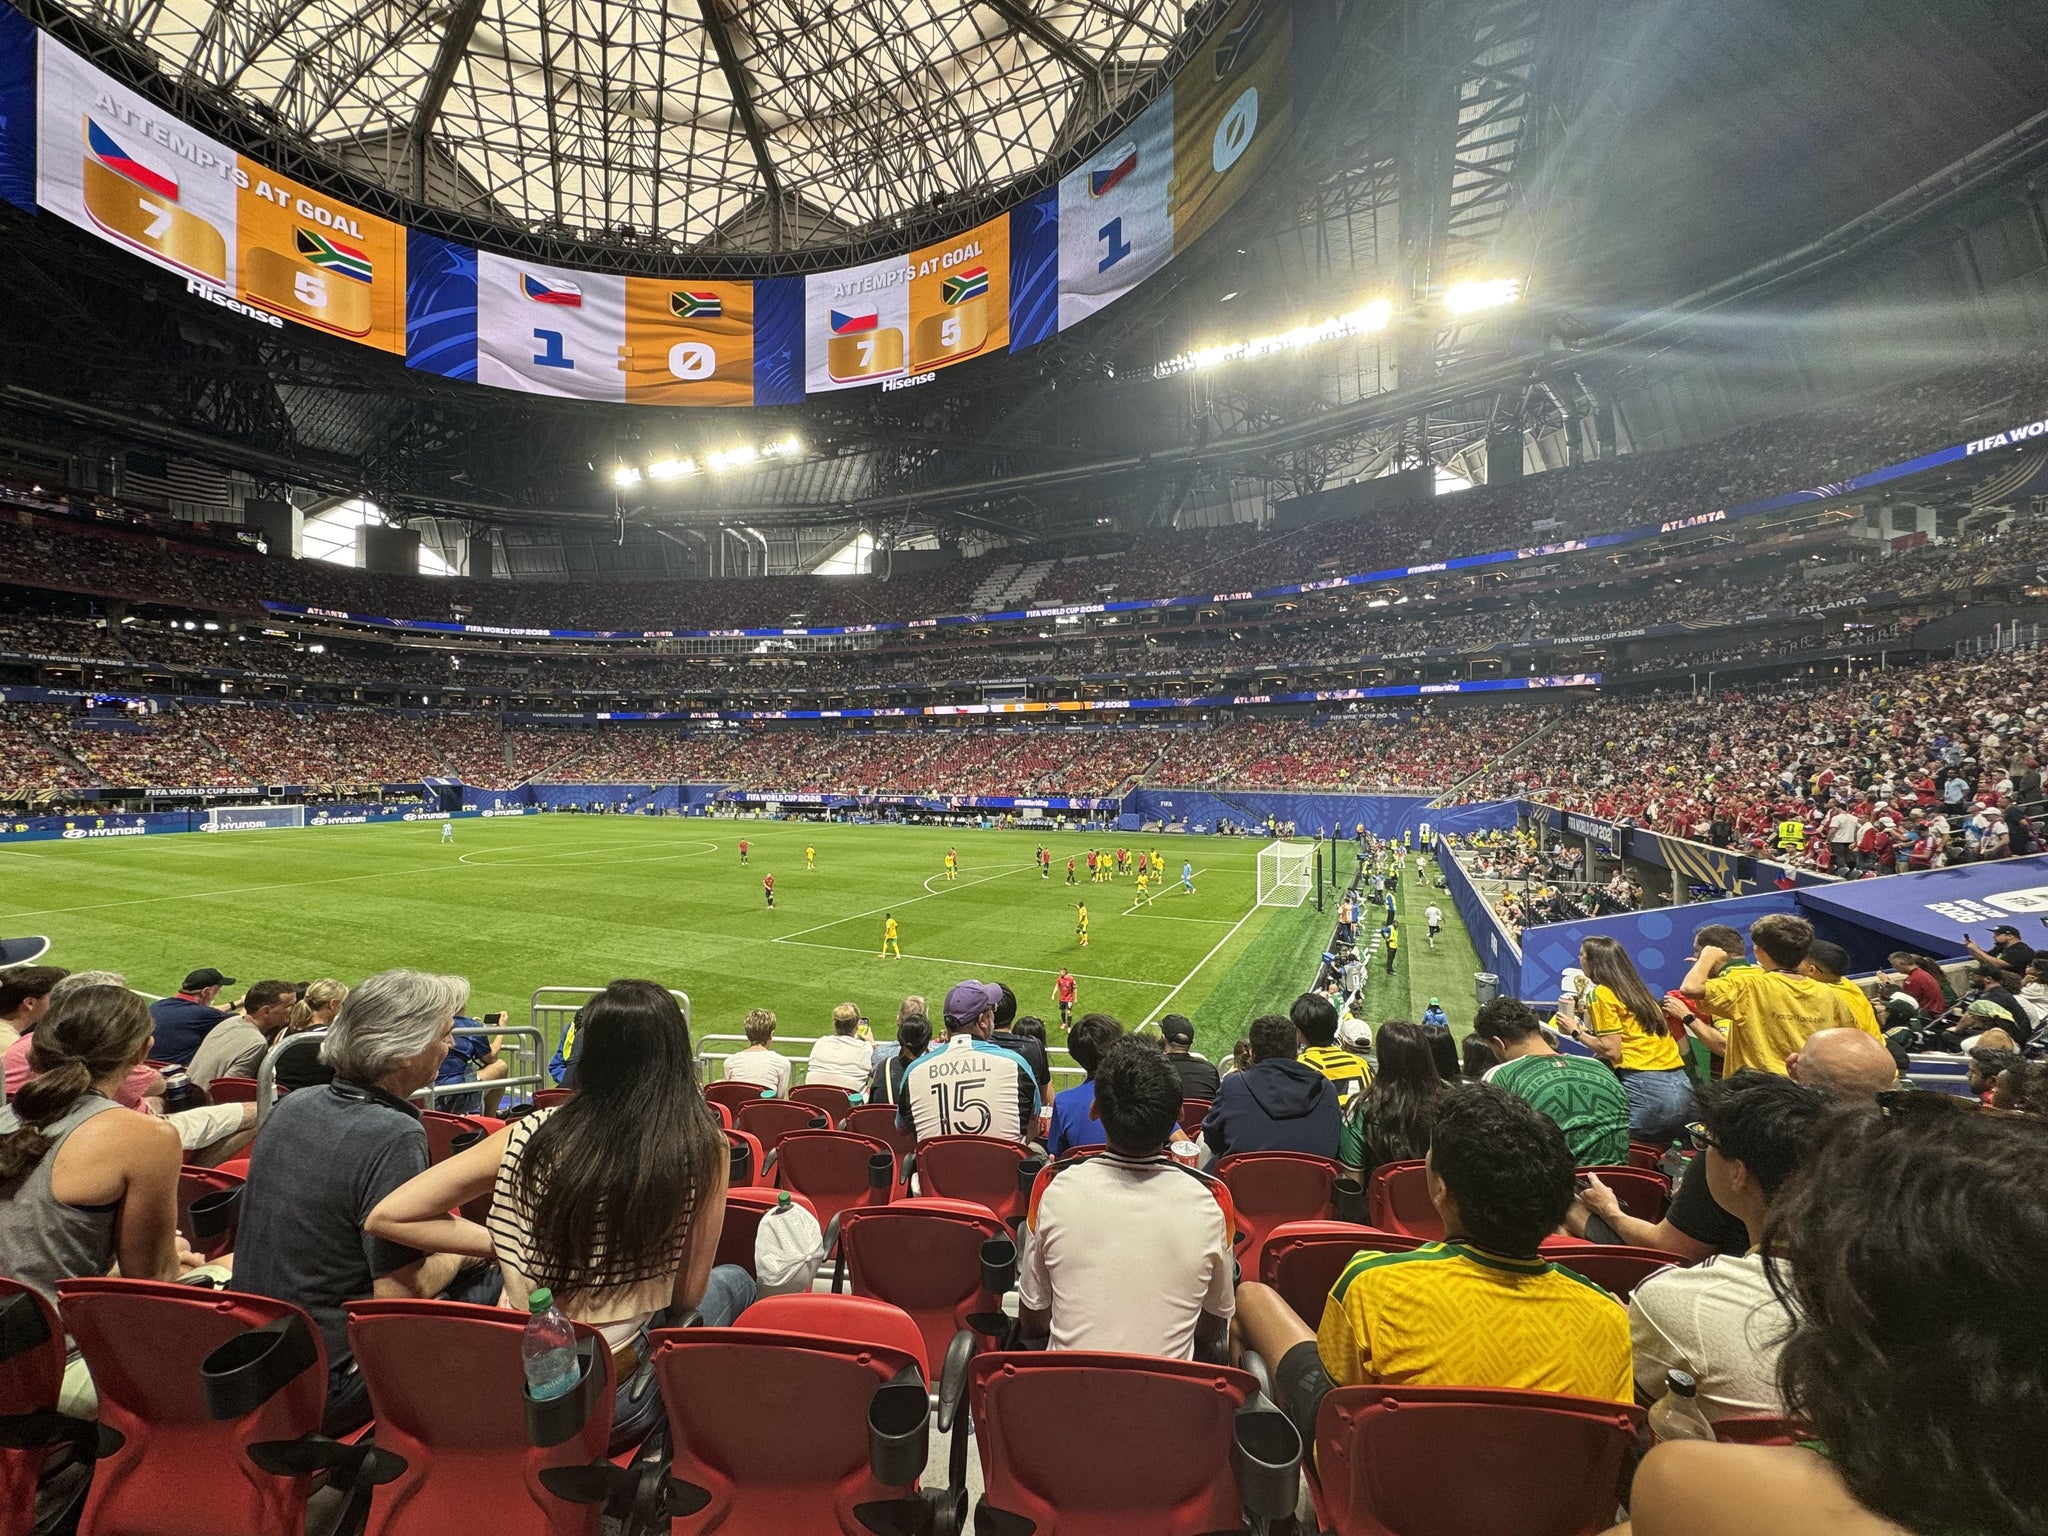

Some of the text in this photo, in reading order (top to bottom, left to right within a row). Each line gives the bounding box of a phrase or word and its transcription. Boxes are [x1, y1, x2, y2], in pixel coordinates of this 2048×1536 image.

[96, 91, 364, 240] ATTEMPTS AT GOAL
[139, 197, 173, 240] 7
[1098, 216, 1131, 274] 1
[834, 241, 983, 298] ATTEMPTS AT GOAL
[294, 271, 328, 308] 5
[186, 278, 284, 329] Hisense
[941, 317, 962, 347] 5
[534, 327, 575, 370] 1
[856, 339, 875, 367] 7
[882, 371, 936, 392] Hisense
[1966, 433, 2008, 456] FIFA
[1661, 509, 1726, 533] ATLANTA
[1214, 592, 1252, 602] ATLANTA
[1798, 596, 1867, 614] ATLANTA
[307, 608, 348, 620] ATLANTA
[1026, 610, 1040, 618] FIFA
[1040, 608, 1065, 616] WORLD
[466, 625, 482, 633] FIFA
[483, 626, 510, 634] WORLD
[908, 620, 936, 628] ATLANTA
[1617, 629, 1645, 637] 2026
[49, 655, 78, 663] WORLD
[1381, 651, 1427, 660] ATLANTA
[48, 689, 108, 698] ATLANTA
[1234, 696, 1270, 704] ATLANTA
[169, 788, 206, 796] WORLD
[220, 821, 266, 830] HYUNDAI
[328, 816, 366, 824] HYUNDAI
[418, 812, 450, 820] HYUNDAI
[88, 827, 145, 837] HYUNDAI
[1568, 816, 1612, 842] FIFA WORLD CUP 202
[1924, 902, 1987, 923] 2026
[928, 1058, 991, 1079] BOXALL
[931, 1078, 992, 1135] 15
